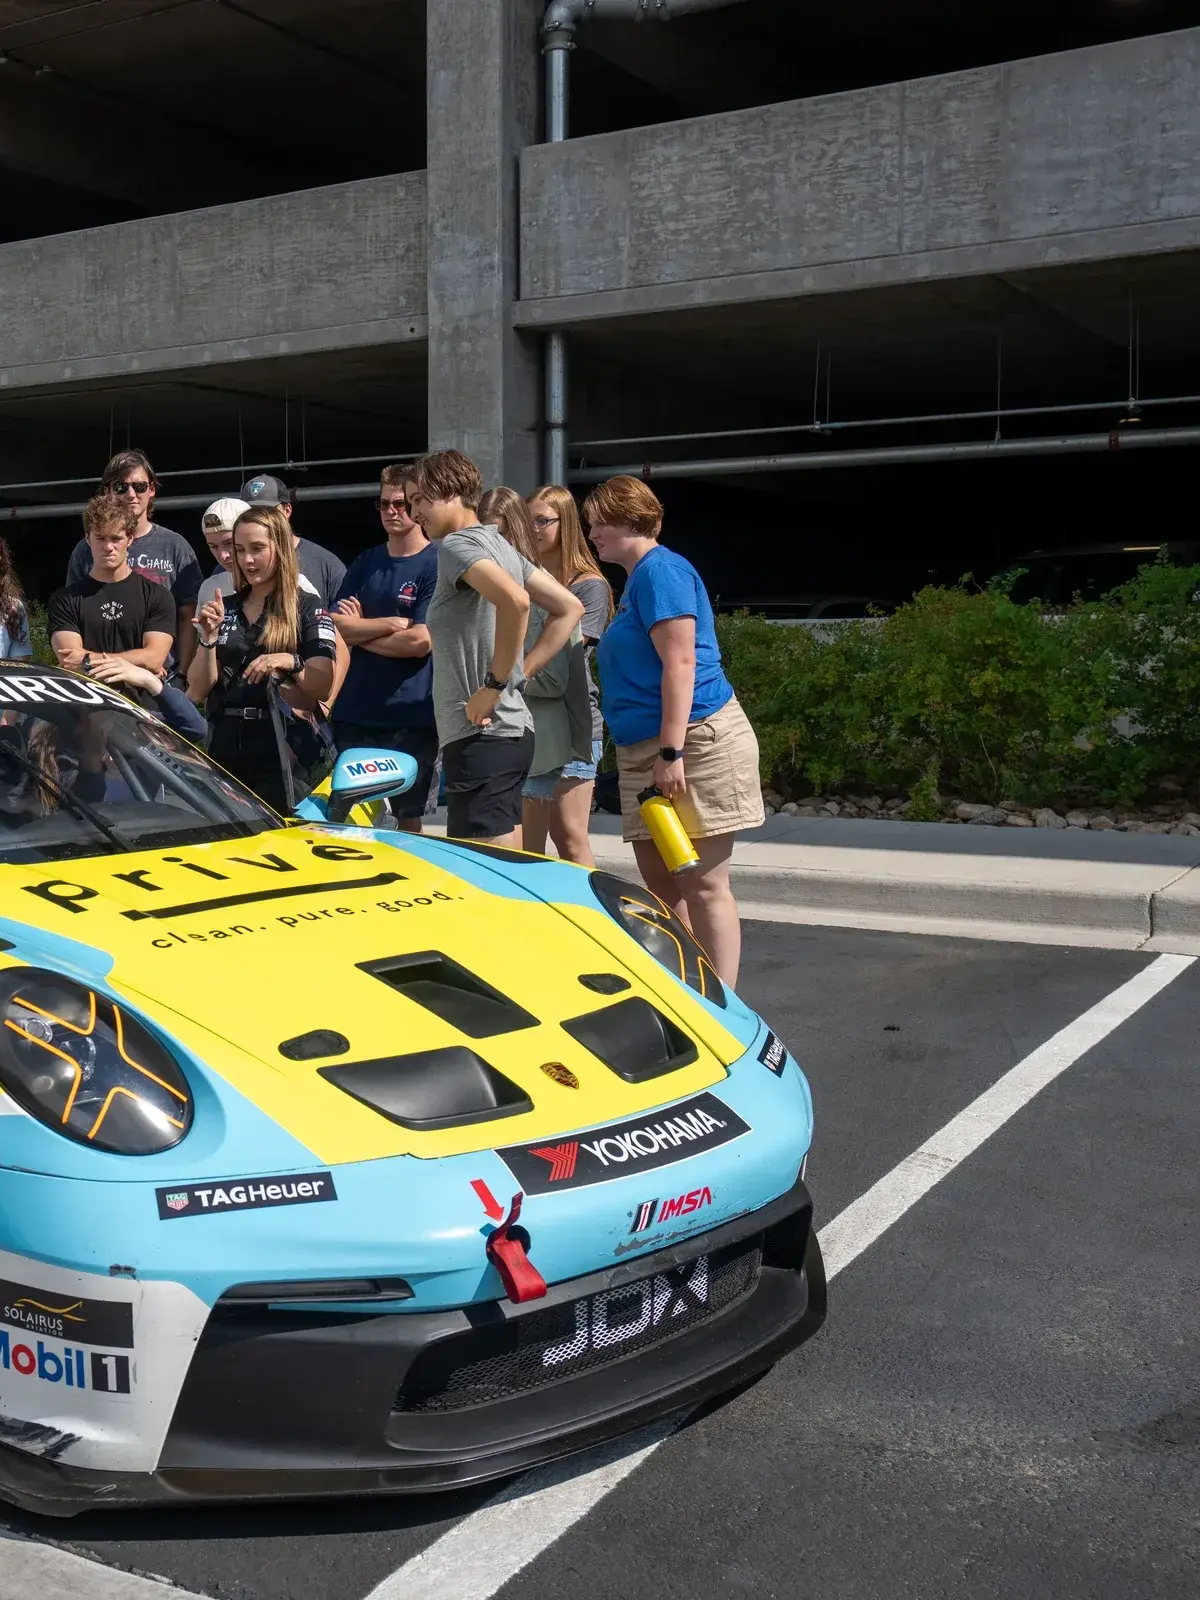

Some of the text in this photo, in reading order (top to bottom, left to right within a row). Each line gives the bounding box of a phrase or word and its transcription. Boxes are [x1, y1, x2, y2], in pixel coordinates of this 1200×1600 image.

[346, 759, 399, 777] Mobil
[20, 838, 375, 915] privé
[150, 889, 465, 949] clean. pure. good.
[580, 1107, 725, 1167] YOKOHAMA
[657, 1186, 713, 1224] IMSA
[3, 1305, 64, 1331] SOLAIRUS
[25, 1323, 64, 1338] AVIATION
[101, 1355, 118, 1392] 1
